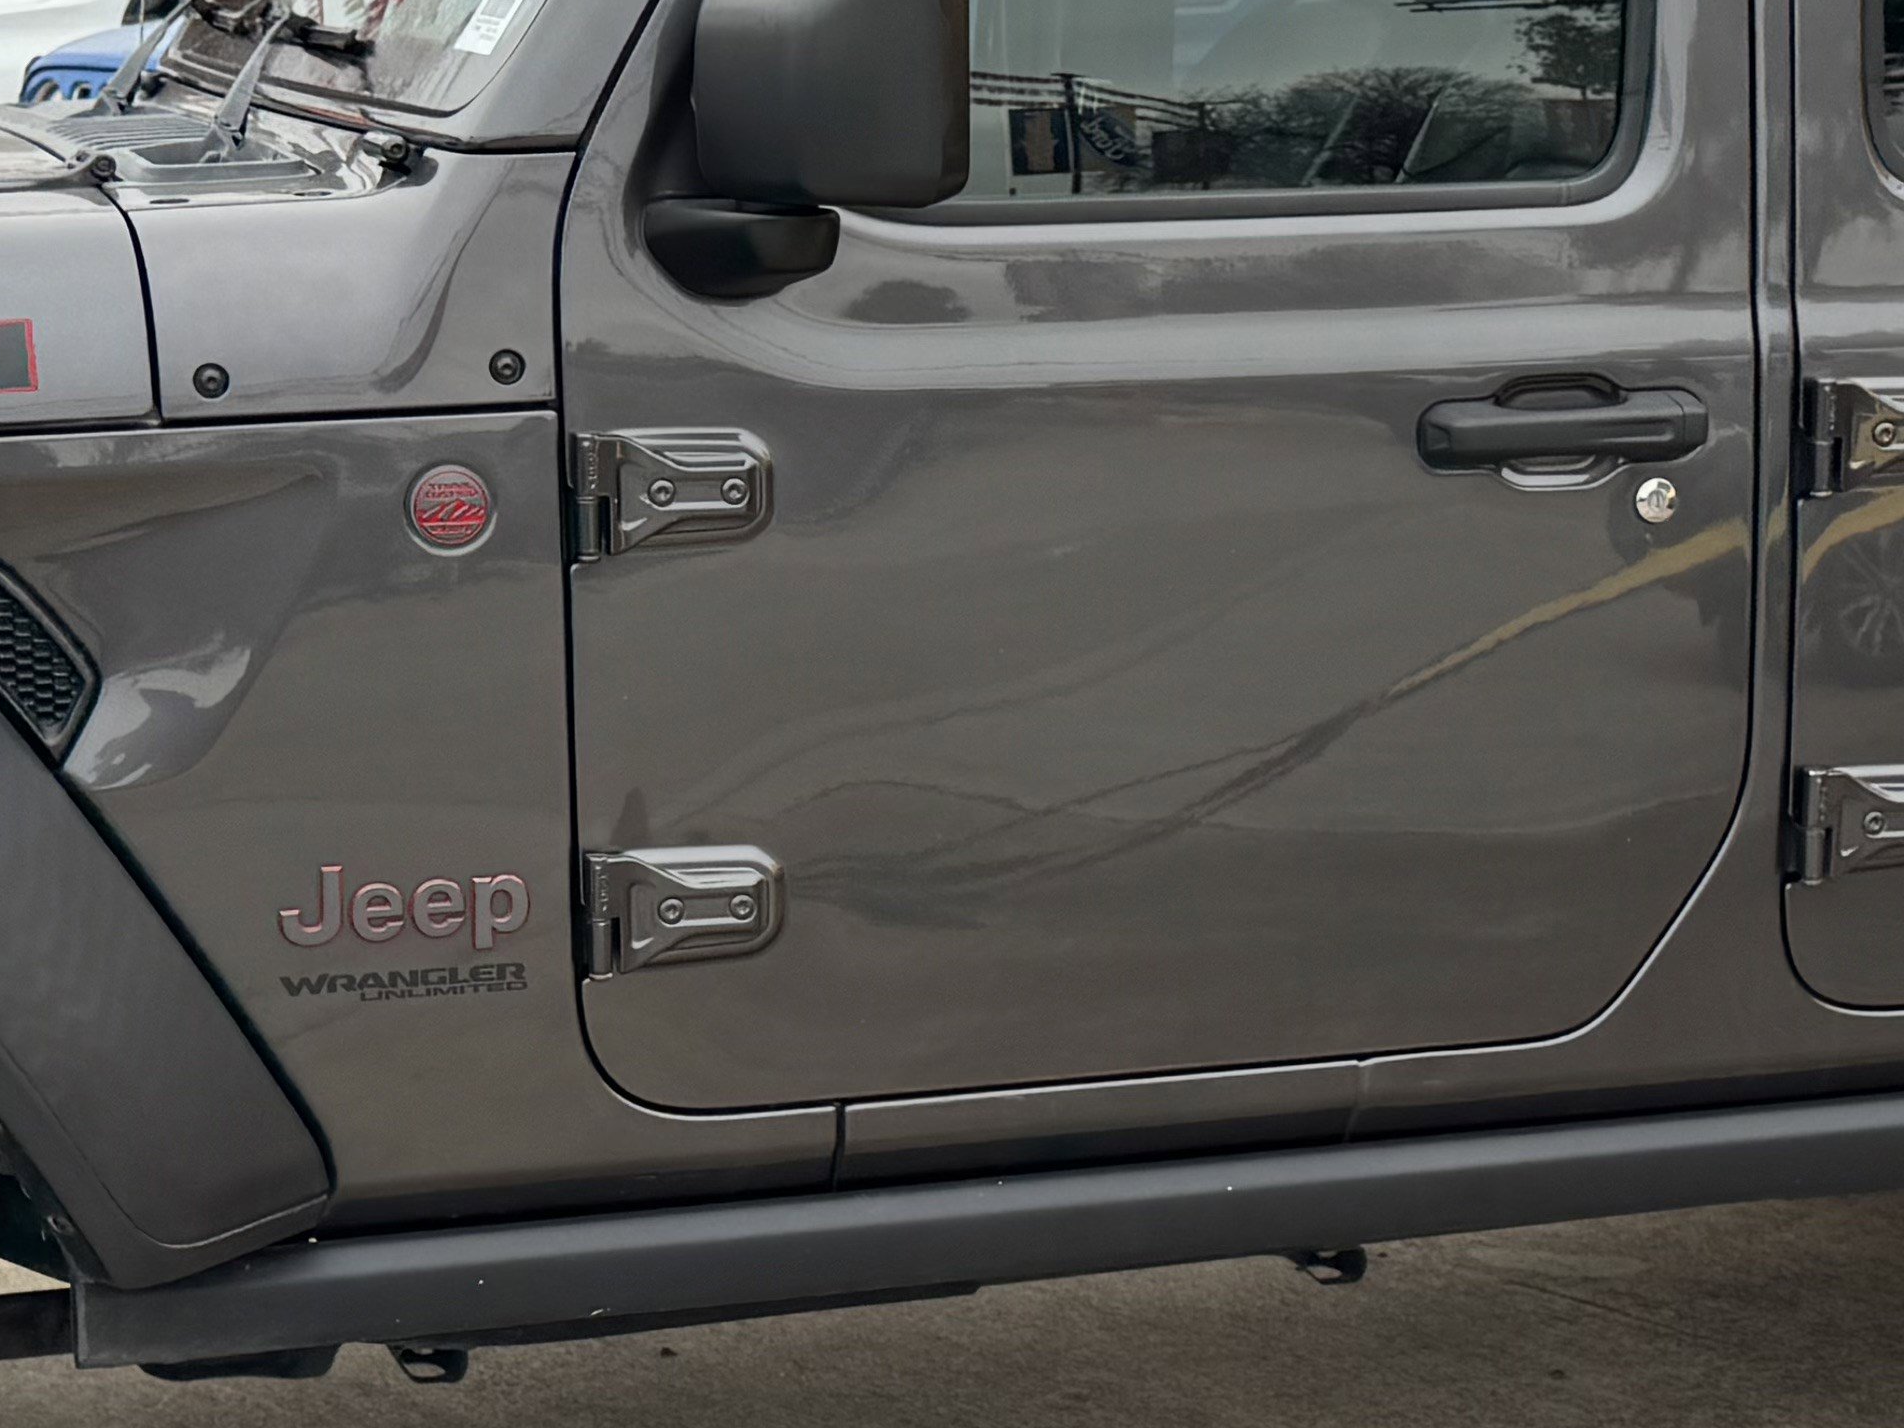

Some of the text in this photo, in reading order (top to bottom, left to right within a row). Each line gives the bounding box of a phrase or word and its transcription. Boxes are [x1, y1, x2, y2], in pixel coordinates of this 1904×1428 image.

[278, 864, 531, 950] Jeep
[278, 961, 527, 997] WRANGLER
[359, 981, 528, 1002] UNLIMITED
